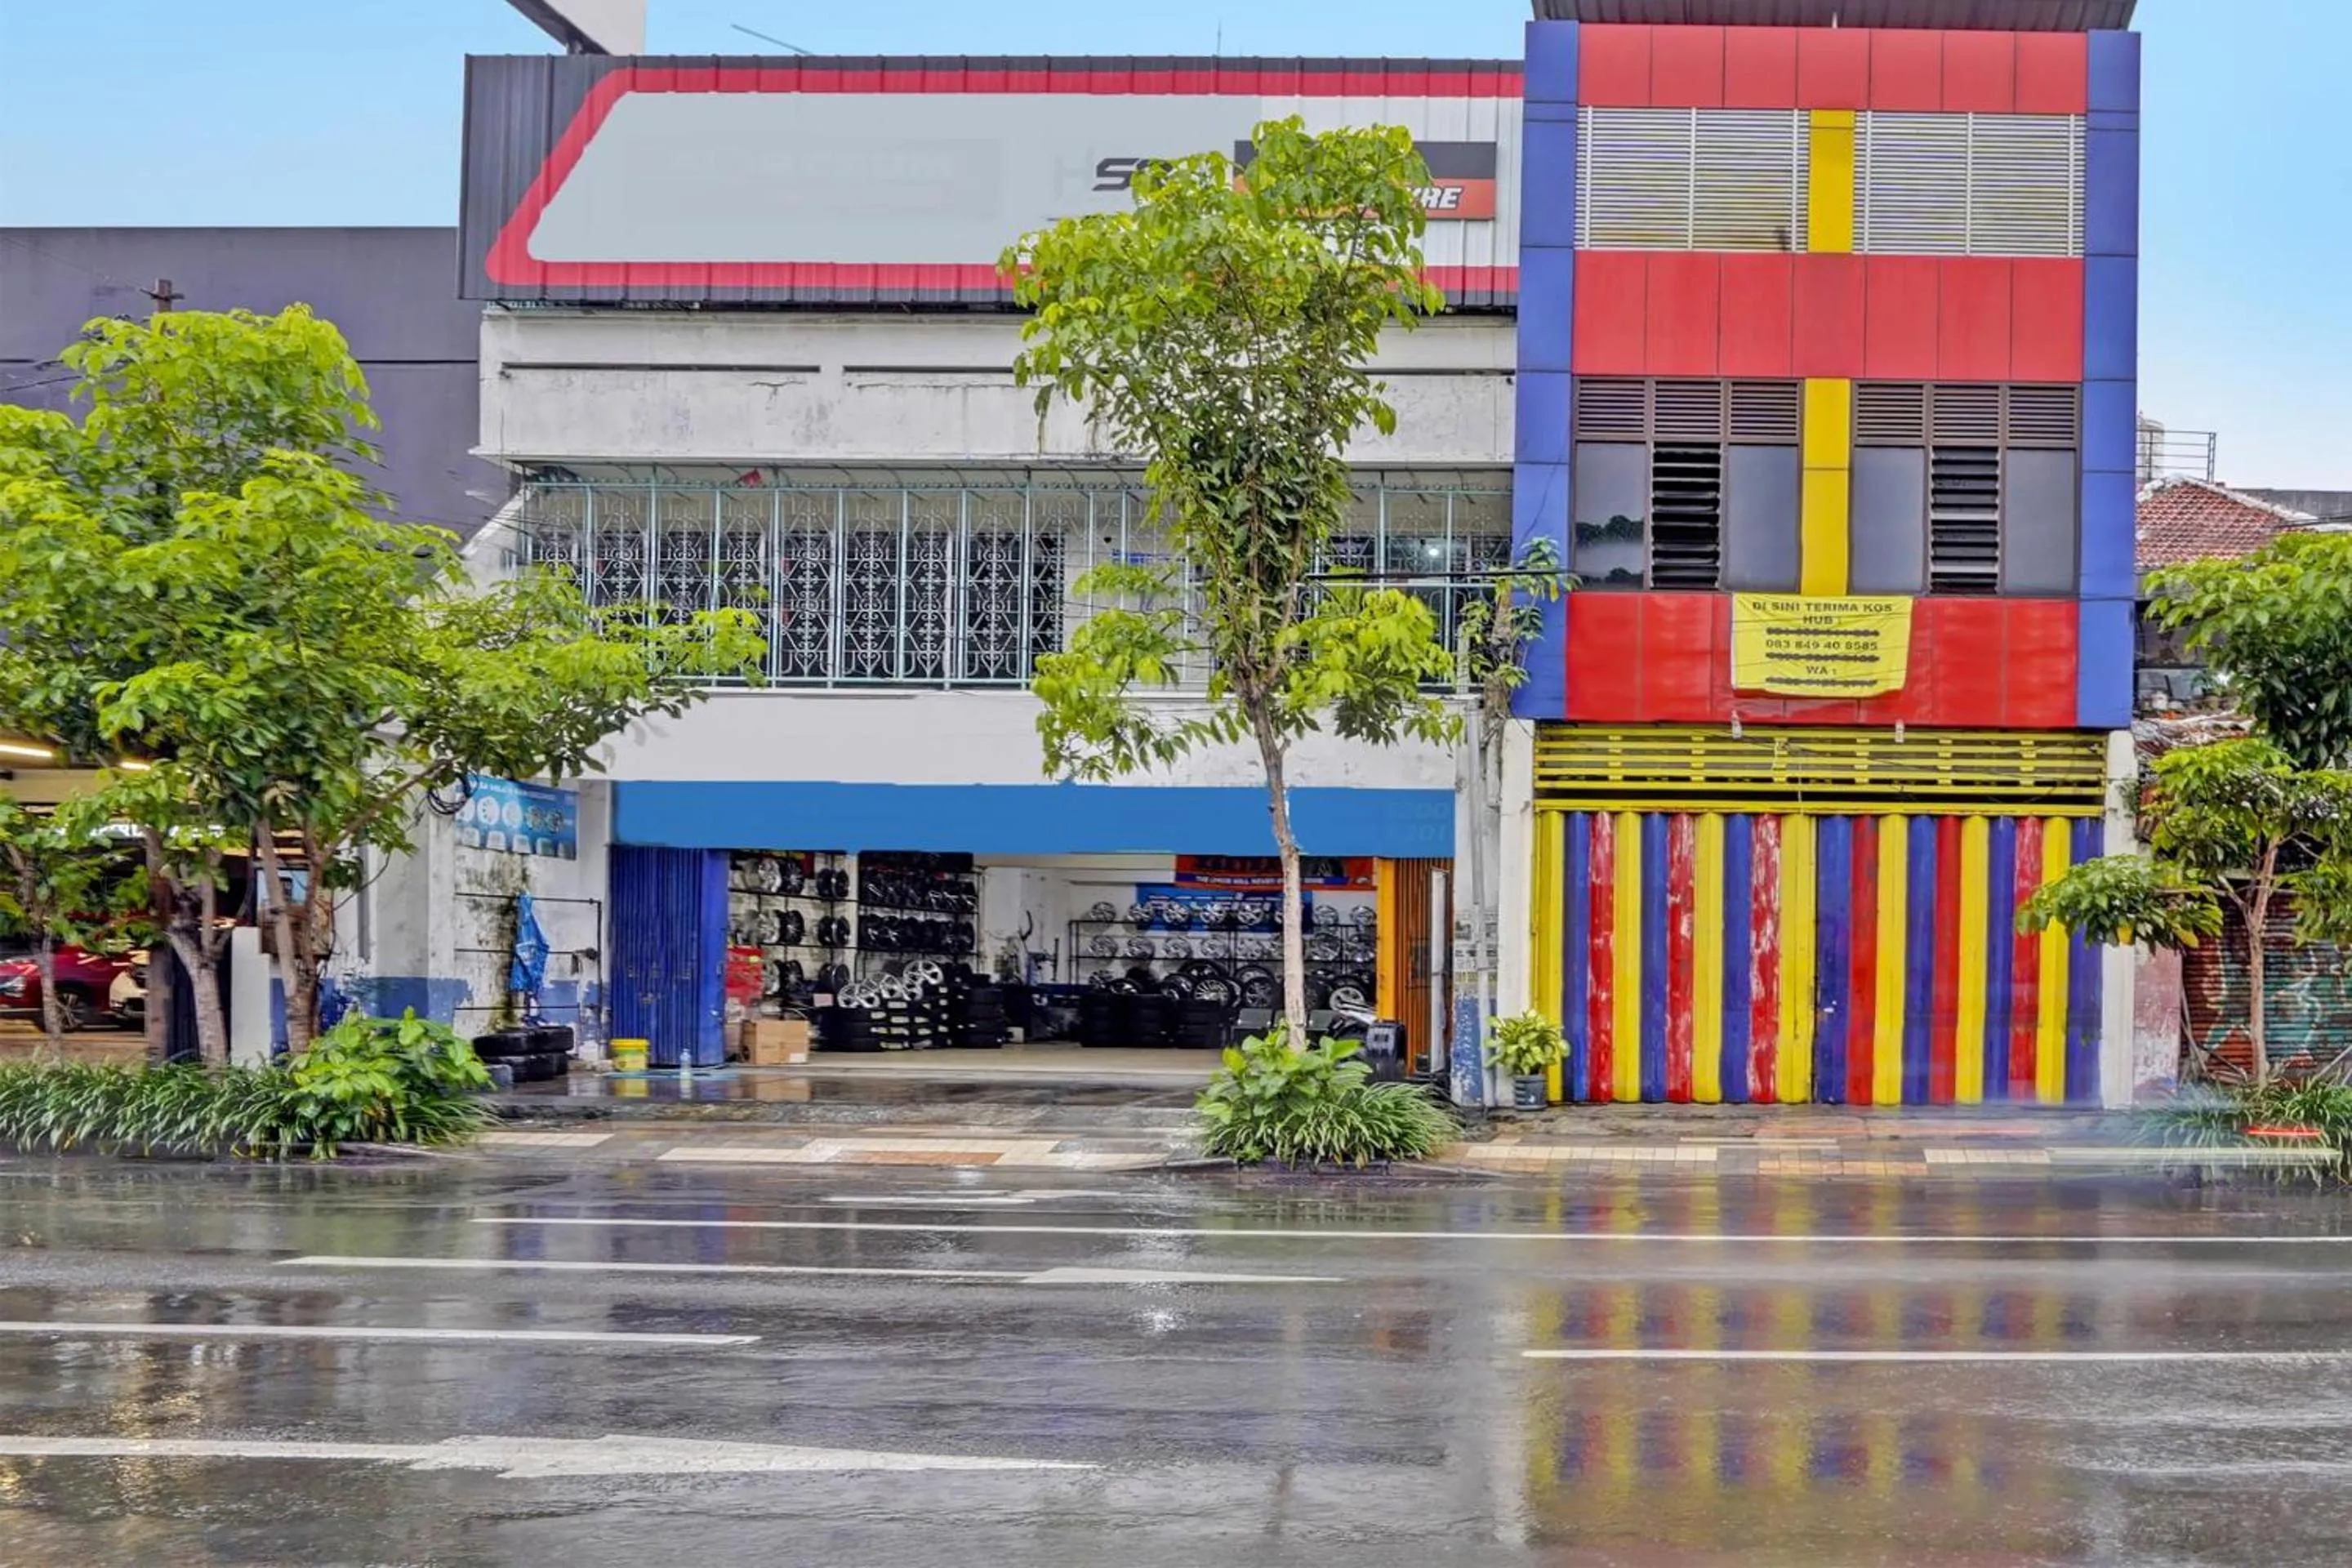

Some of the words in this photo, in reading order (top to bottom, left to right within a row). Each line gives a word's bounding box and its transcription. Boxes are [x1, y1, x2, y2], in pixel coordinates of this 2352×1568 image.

[1772, 602, 1800, 612] SINI
[1806, 603, 1859, 612] TERIMA
[1863, 604, 1893, 612] KOS
[1803, 615, 1833, 625] HUB
[1806, 666, 1828, 675] WA
